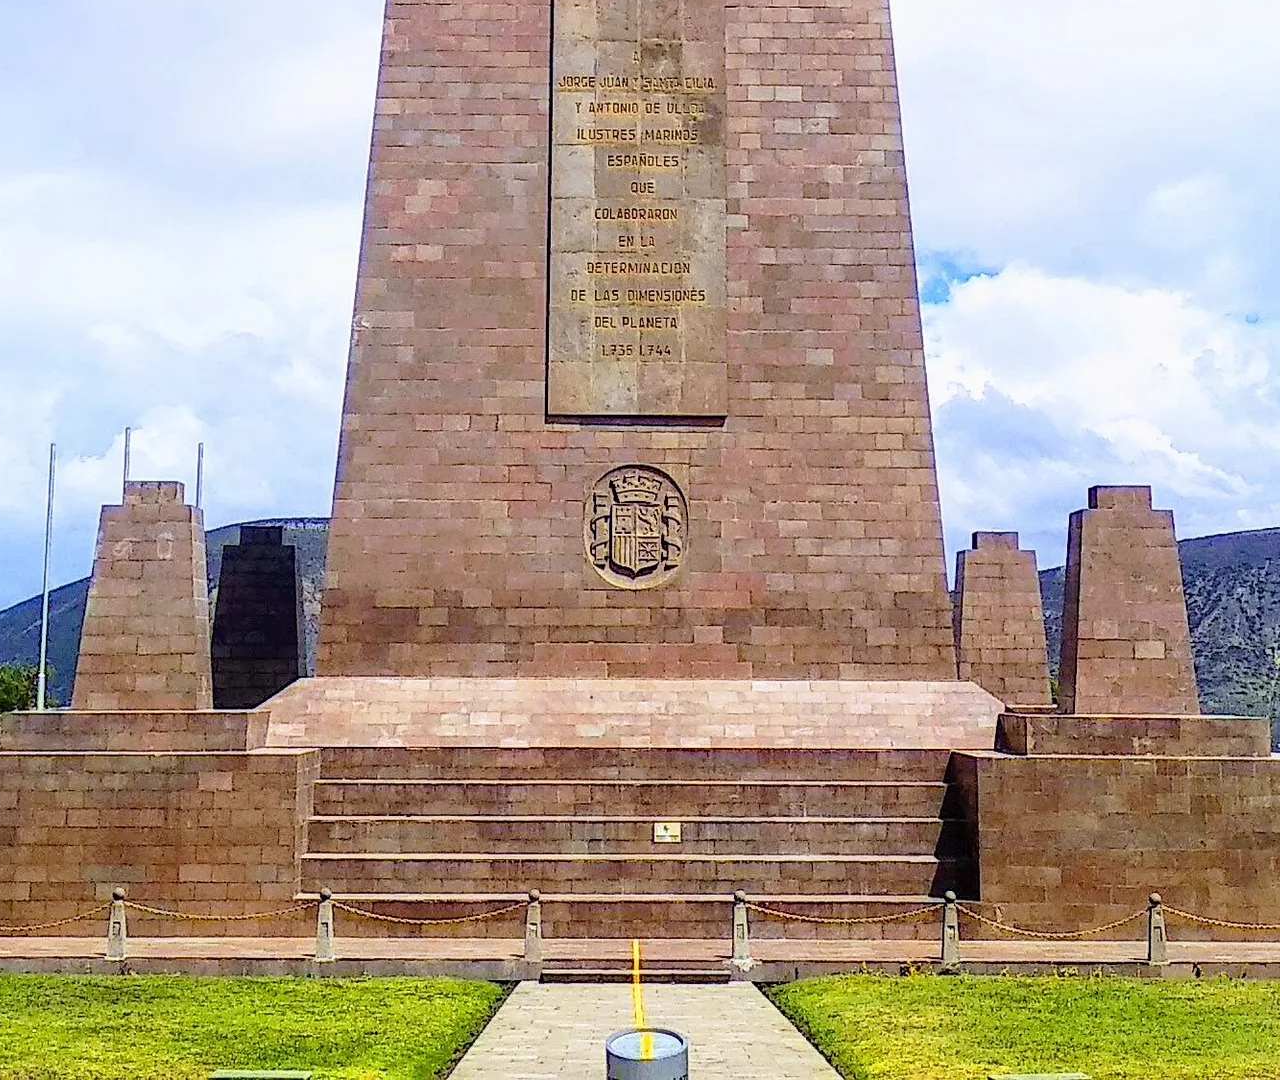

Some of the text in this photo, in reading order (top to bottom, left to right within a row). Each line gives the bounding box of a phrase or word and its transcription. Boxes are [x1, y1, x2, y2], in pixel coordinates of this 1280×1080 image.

[558, 76, 596, 88] JORGE
[599, 76, 629, 88] JUAN
[575, 102, 705, 114] Y ANTONIO DE ULLOA
[577, 128, 698, 141] ILUSTRES MARINOS
[607, 153, 679, 167] ESPAÑOLES
[630, 182, 655, 194] QUE
[594, 208, 678, 220] COLABORARON
[618, 235, 656, 247] EN LA
[586, 262, 691, 274] DETERMINACION
[571, 289, 705, 301] DE LAS DIMENSIONES
[594, 316, 677, 329] DEL PLANETA
